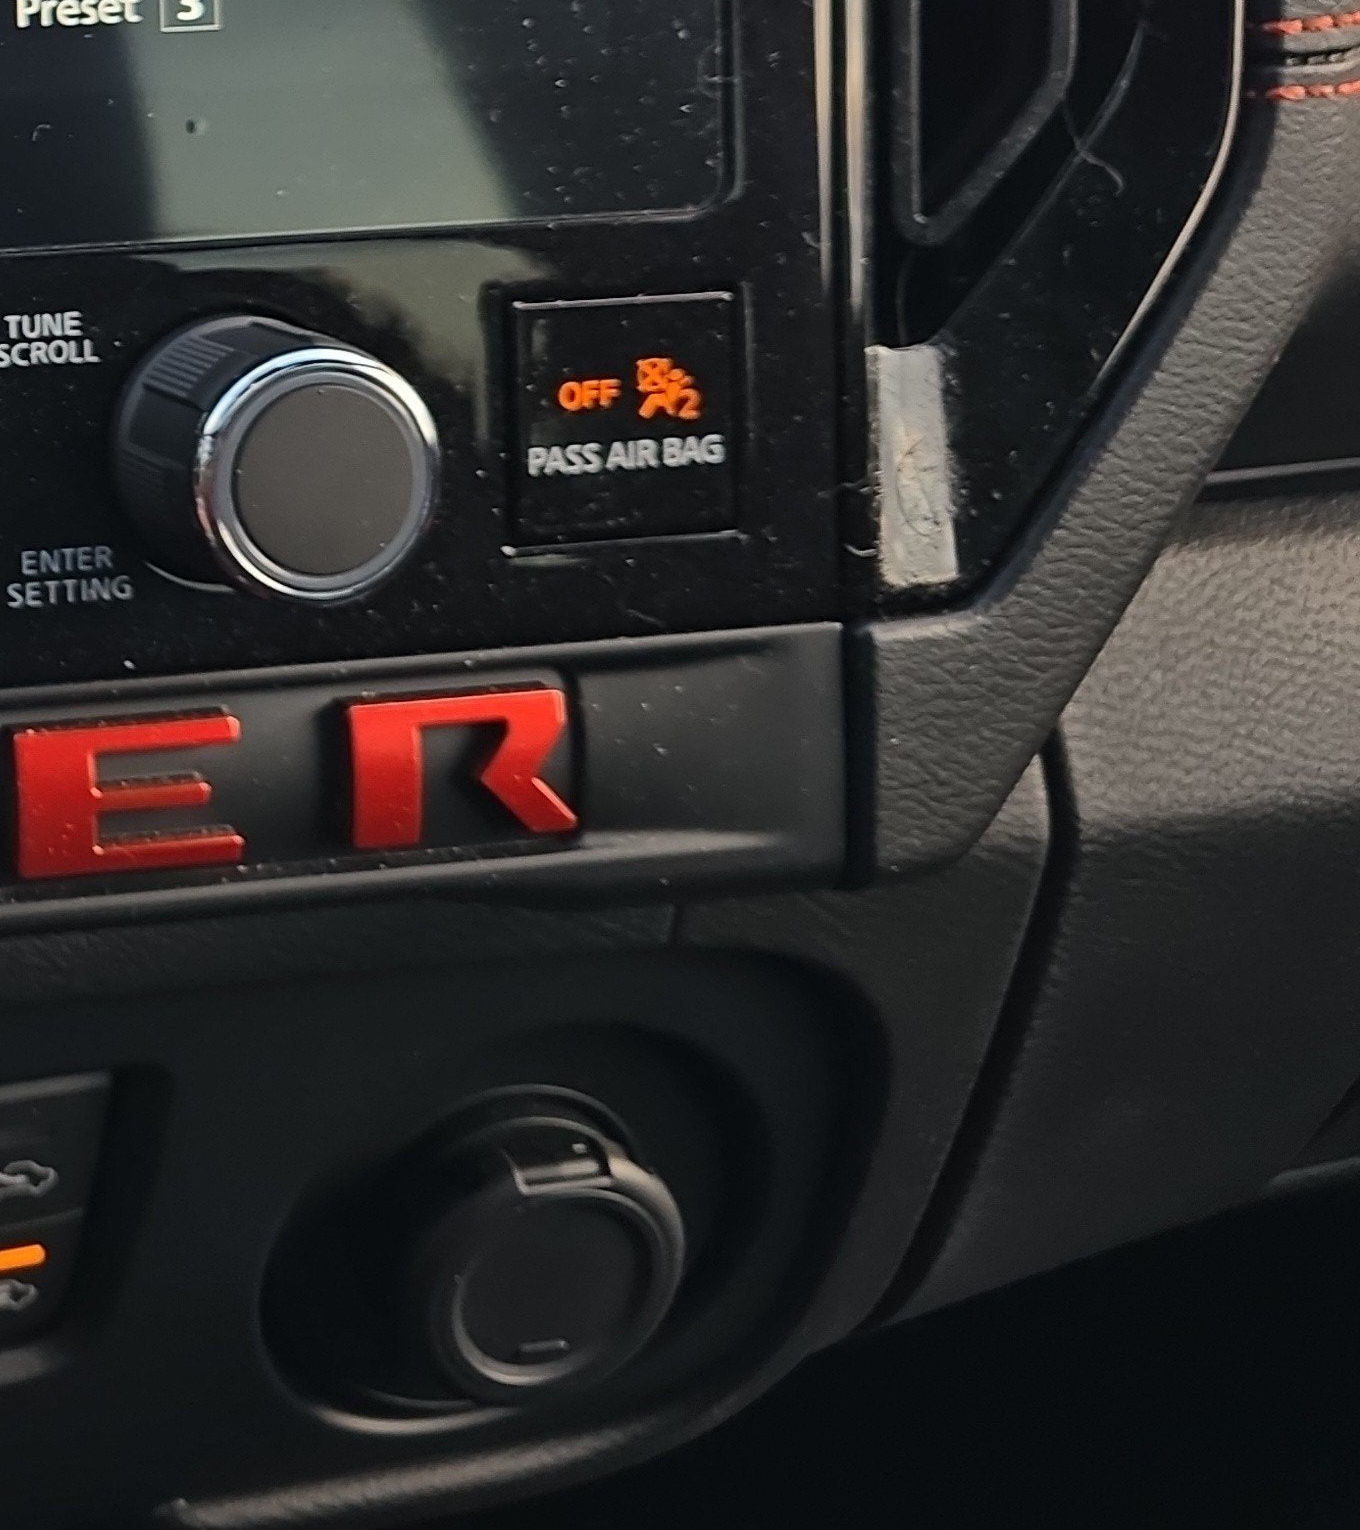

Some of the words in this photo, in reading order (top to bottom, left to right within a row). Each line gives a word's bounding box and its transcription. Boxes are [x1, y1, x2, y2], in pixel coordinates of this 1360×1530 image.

[2, 310, 84, 340] TUNE
[558, 377, 623, 412] OFF
[527, 441, 605, 477] PASS
[605, 437, 661, 471] AIR
[662, 432, 727, 468] BAG
[20, 544, 114, 576] ENTER
[6, 574, 135, 608] SETTING
